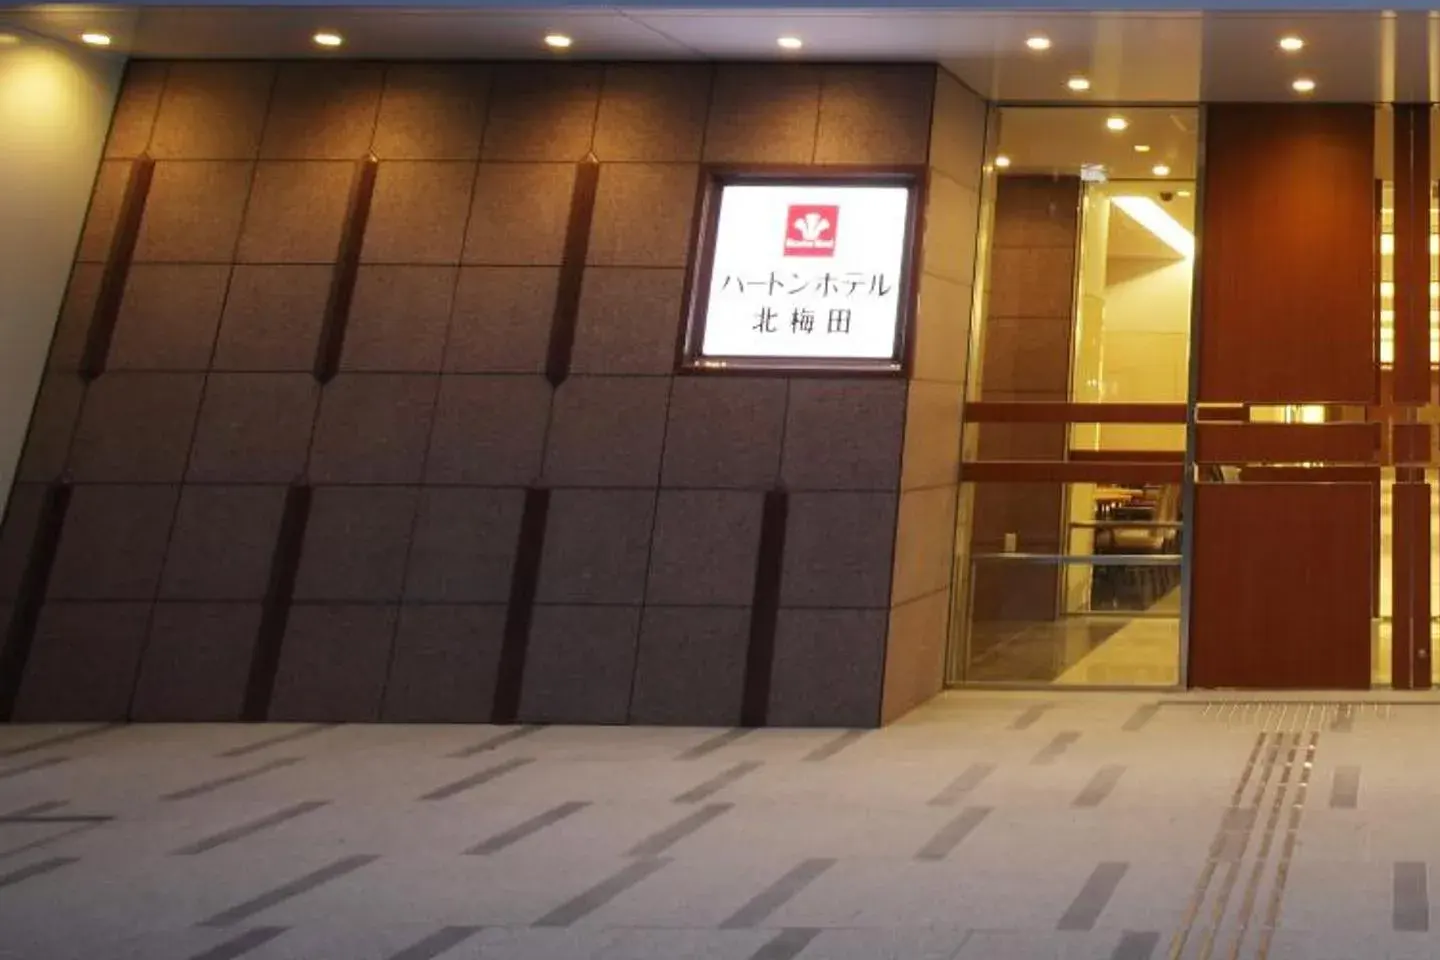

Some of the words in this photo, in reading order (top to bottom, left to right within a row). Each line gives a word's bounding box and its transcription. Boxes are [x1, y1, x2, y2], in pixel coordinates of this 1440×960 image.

[722, 271, 892, 297] ハートンホテル
[752, 305, 852, 334] 北梅田
